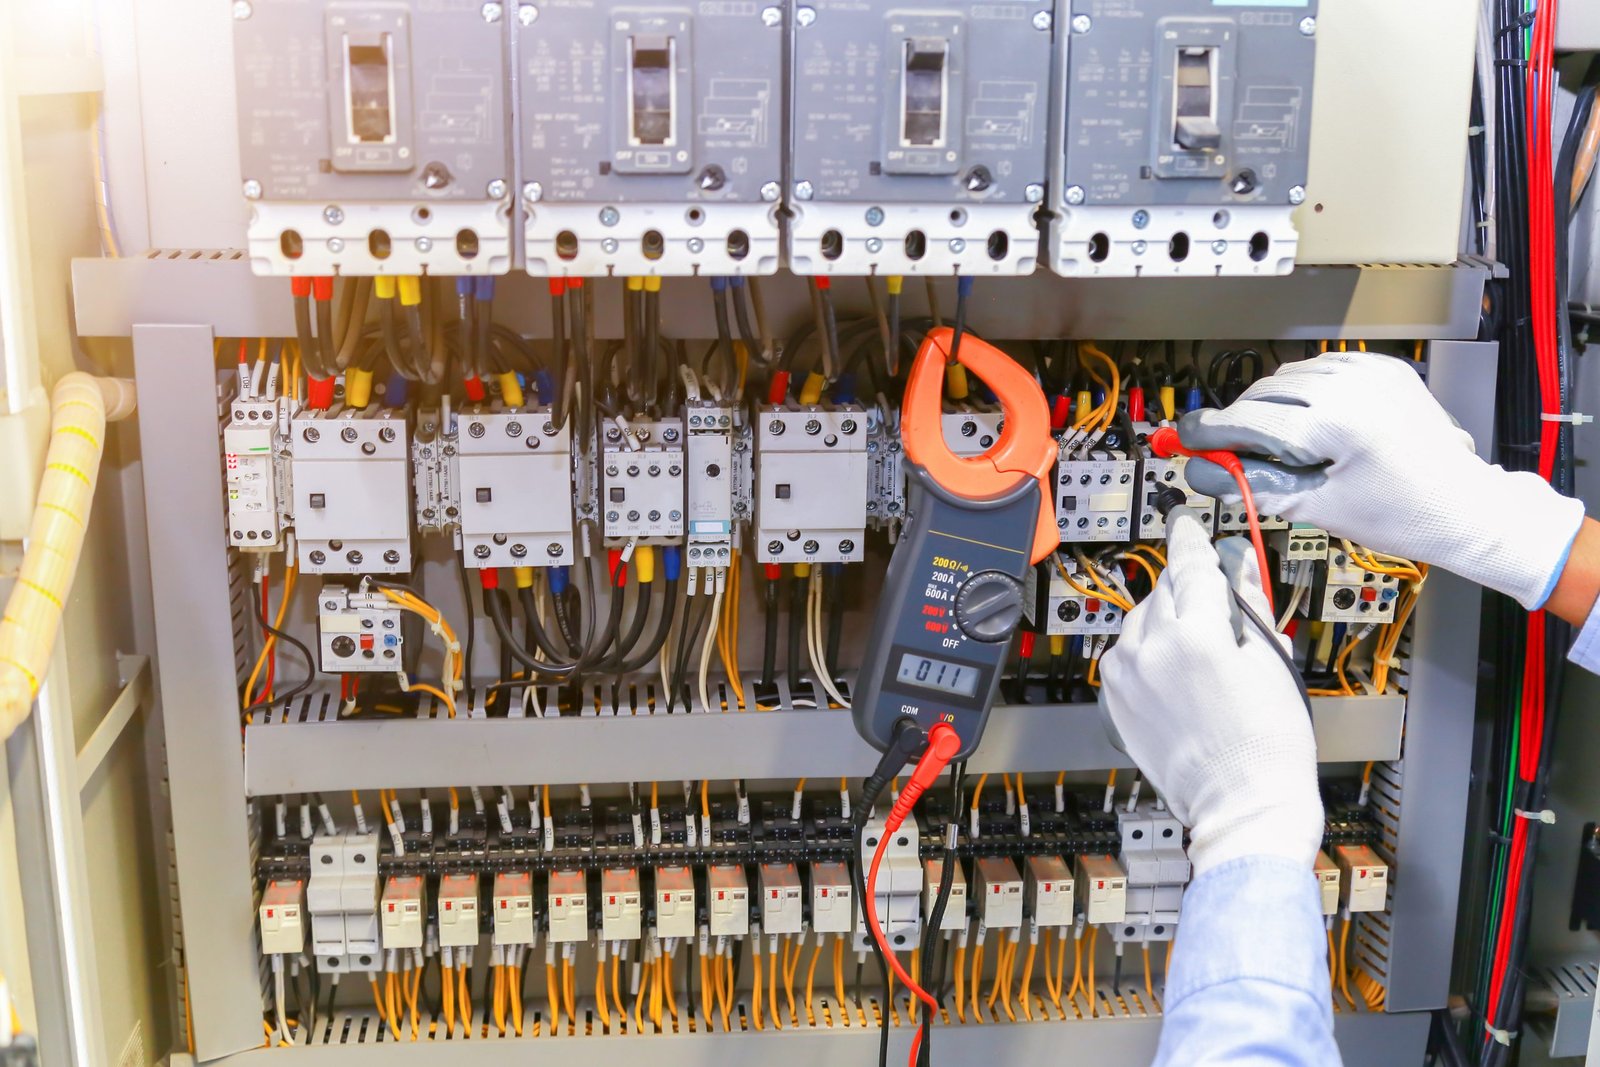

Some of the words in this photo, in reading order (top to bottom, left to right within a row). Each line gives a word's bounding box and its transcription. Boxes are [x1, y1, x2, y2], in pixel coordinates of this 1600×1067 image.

[925, 587, 948, 601] 600A
[942, 638, 960, 650] OFF
[901, 704, 919, 716] COM
